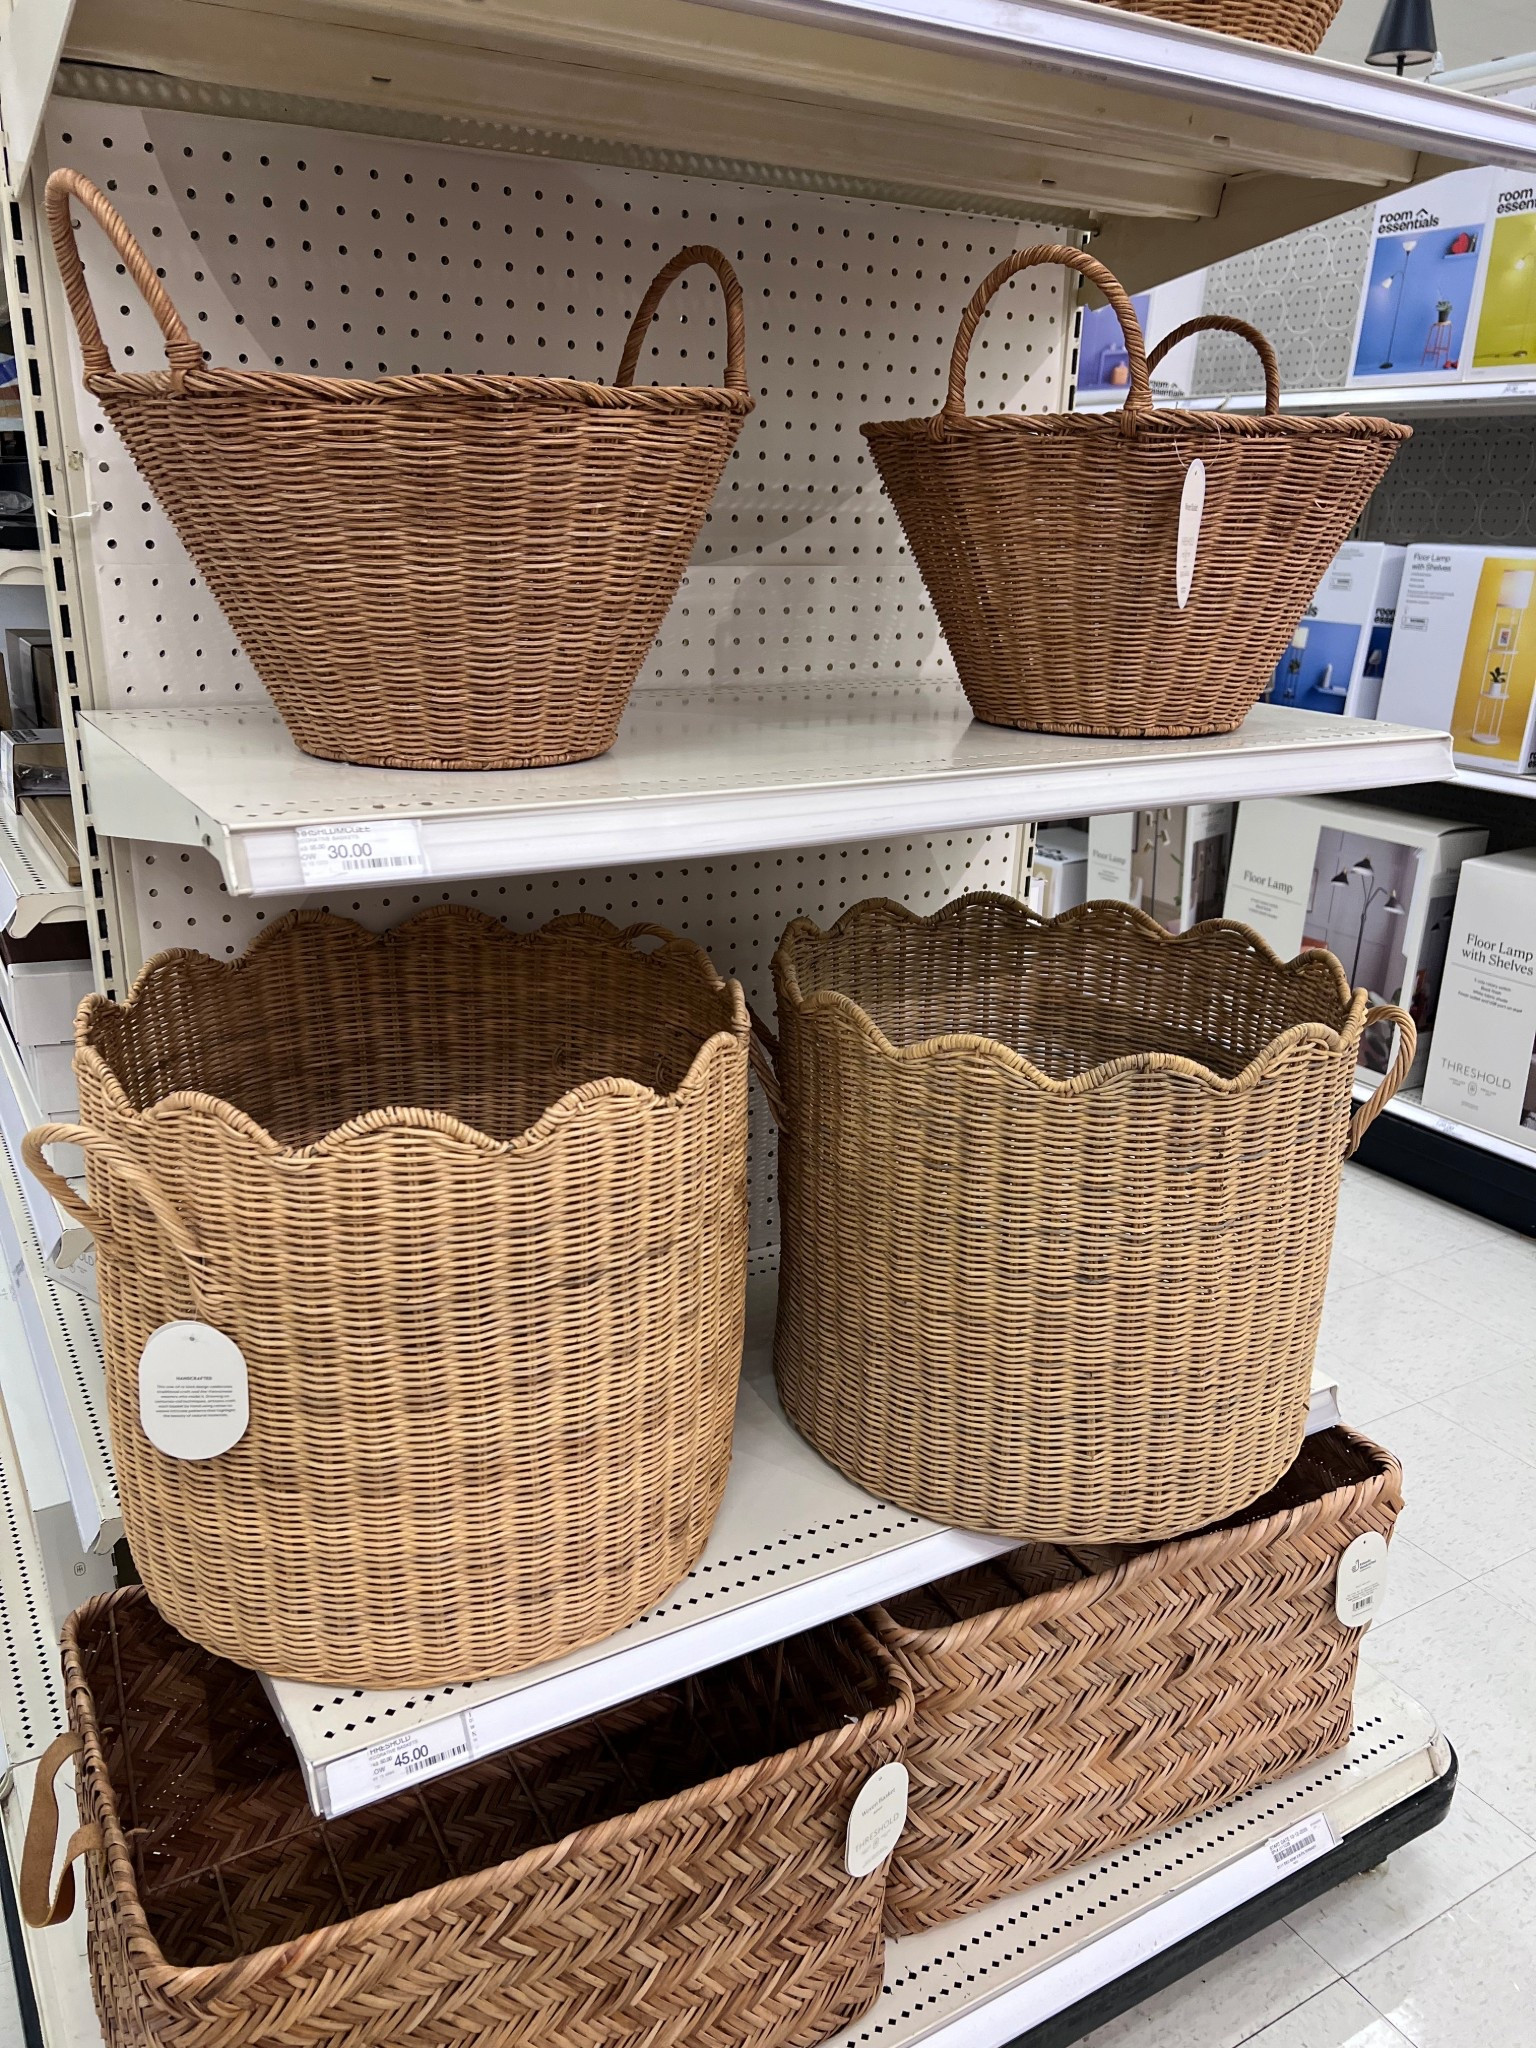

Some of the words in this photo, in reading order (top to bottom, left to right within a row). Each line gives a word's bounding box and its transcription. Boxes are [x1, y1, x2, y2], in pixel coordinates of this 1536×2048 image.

[1499, 188, 1533, 203] room
[1378, 214, 1439, 234] essentials
[1380, 210, 1413, 224] room
[1413, 552, 1430, 561] Floor
[1431, 554, 1451, 563] Lamp
[1426, 563, 1451, 572] Shelves
[327, 842, 373, 860] 30.00
[1093, 849, 1108, 860] Floor
[1109, 853, 1126, 866] Lamp
[1243, 870, 1266, 887] Floor
[1267, 877, 1294, 895] Lamp
[1467, 933, 1497, 951] Floor
[1499, 941, 1534, 963] Lamp
[1462, 948, 1486, 964] with
[1488, 953, 1534, 976] Shelves
[1441, 1056, 1512, 1090] THRESHOLD
[373, 1766, 386, 1775] OW
[394, 1744, 429, 1767] 45.00
[861, 1801, 878, 1817] Woven
[878, 1787, 896, 1803] Basket
[855, 1812, 899, 1853] THRESHOLD
